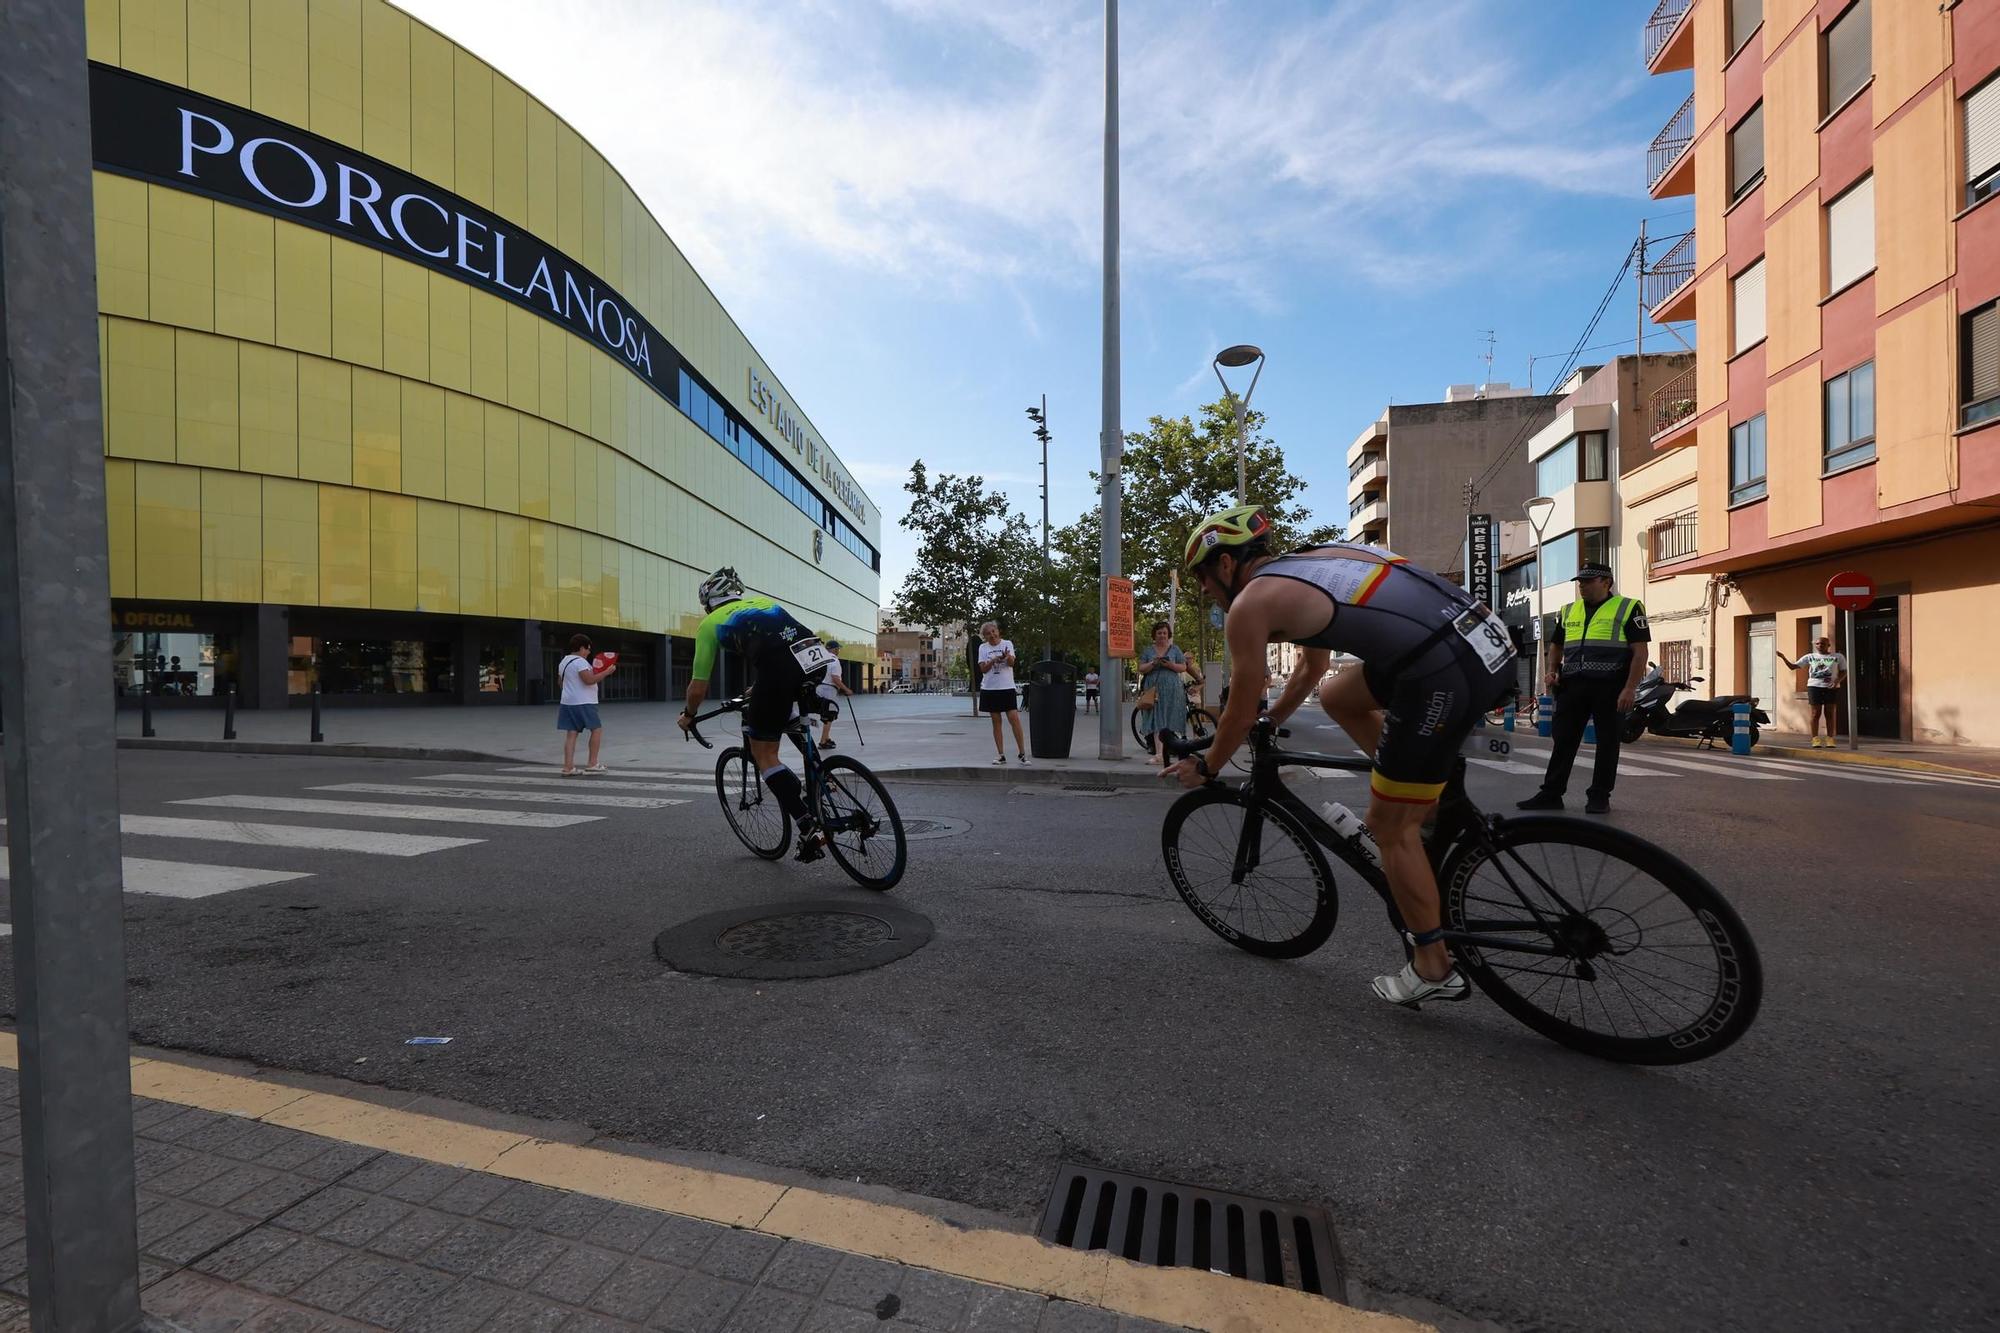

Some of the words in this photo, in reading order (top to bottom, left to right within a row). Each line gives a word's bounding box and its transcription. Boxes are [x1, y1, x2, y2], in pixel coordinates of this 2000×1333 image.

[176, 106, 653, 378] PORCELANOSA
[748, 366, 804, 456] ESTADIO
[806, 438, 818, 474] DE
[1474, 527, 1487, 603] RESTAURAN
[124, 612, 194, 627] OFICIAL
[808, 648, 825, 663] 27
[1489, 739, 1510, 755] 80
